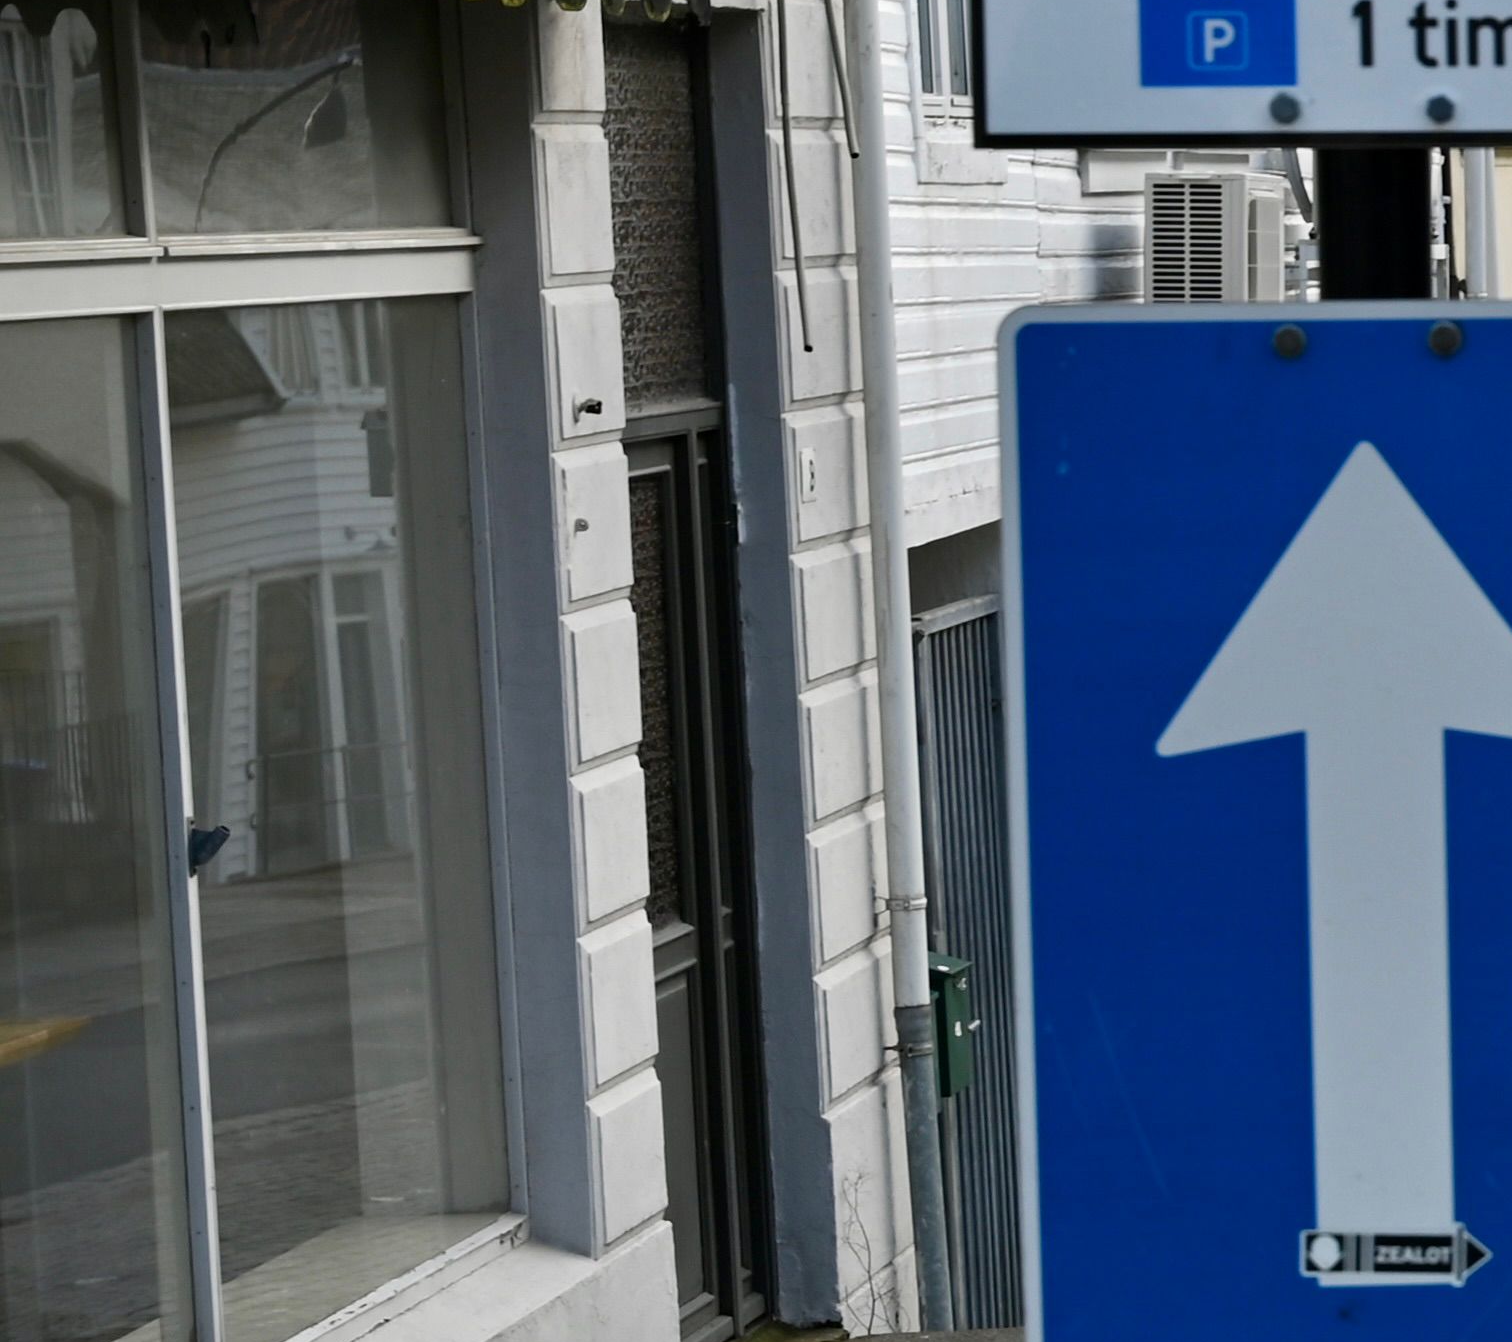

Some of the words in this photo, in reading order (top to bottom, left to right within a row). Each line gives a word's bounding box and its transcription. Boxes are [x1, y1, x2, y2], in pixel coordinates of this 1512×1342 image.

[1202, 19, 1236, 64] P
[1351, 0, 1375, 68] 1
[1375, 1245, 1450, 1265] ZEALOT
